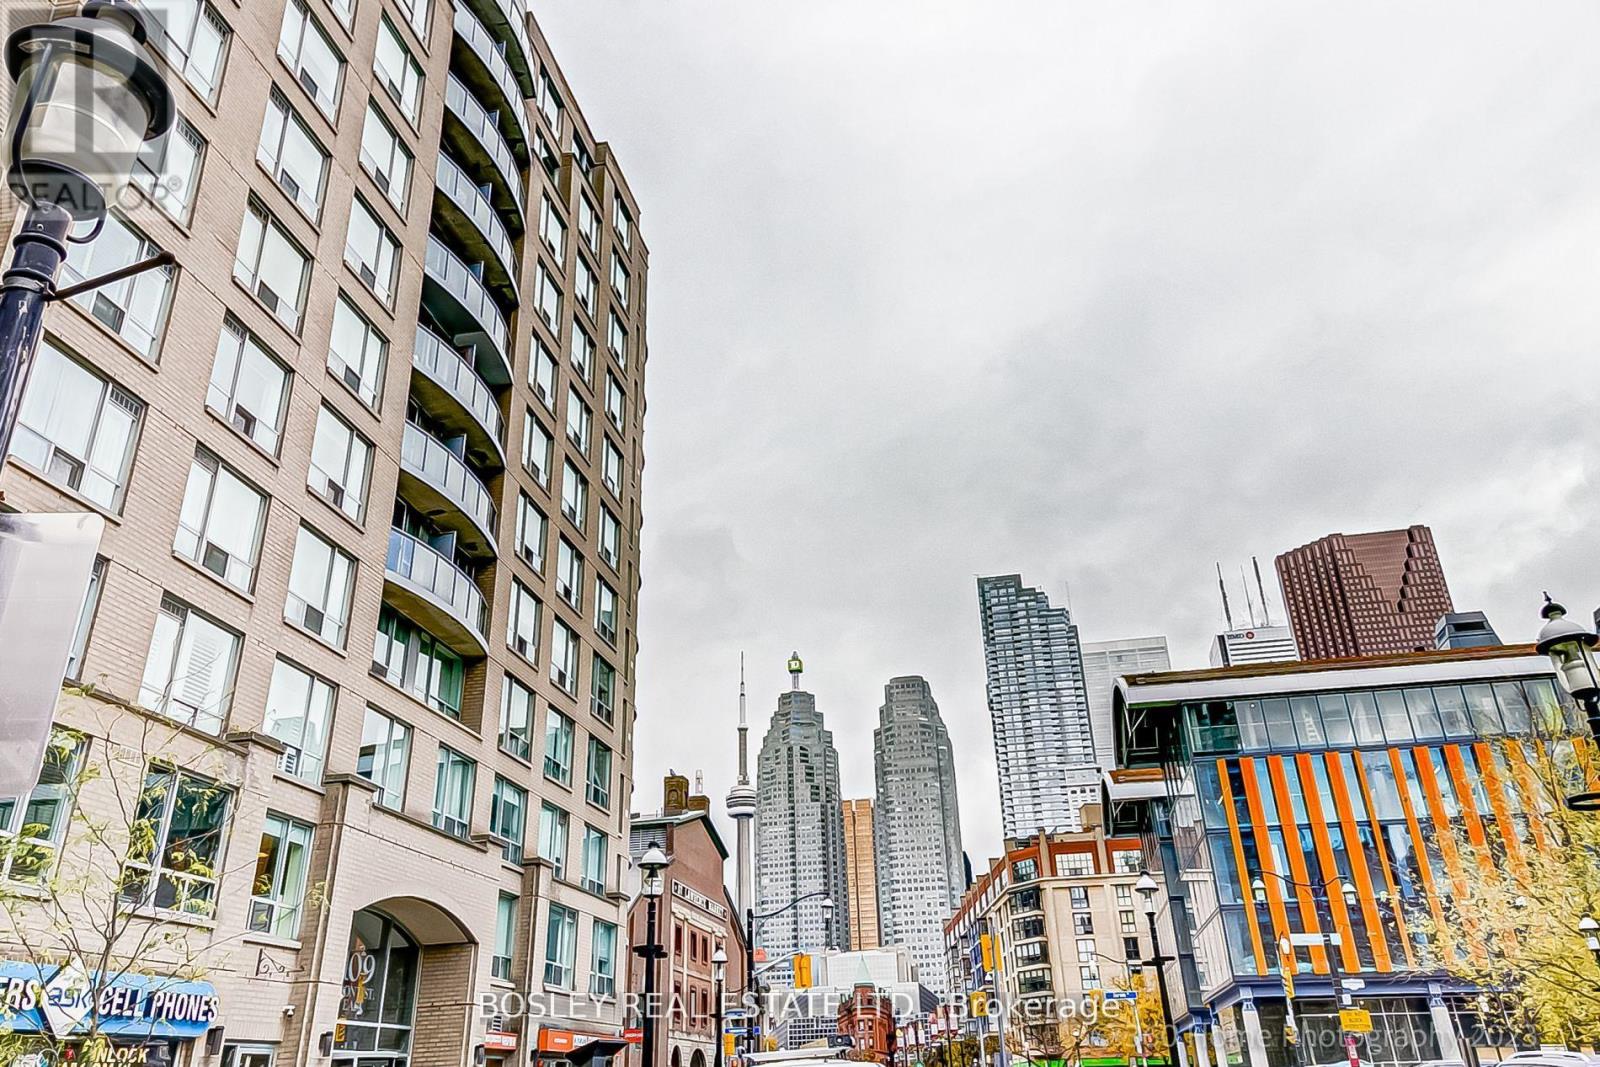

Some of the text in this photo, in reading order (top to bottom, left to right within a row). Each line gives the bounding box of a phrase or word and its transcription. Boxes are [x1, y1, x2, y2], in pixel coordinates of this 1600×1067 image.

[343, 952, 376, 984] 09
[98, 986, 144, 1017] CELL
[150, 991, 220, 1022] PHONES
